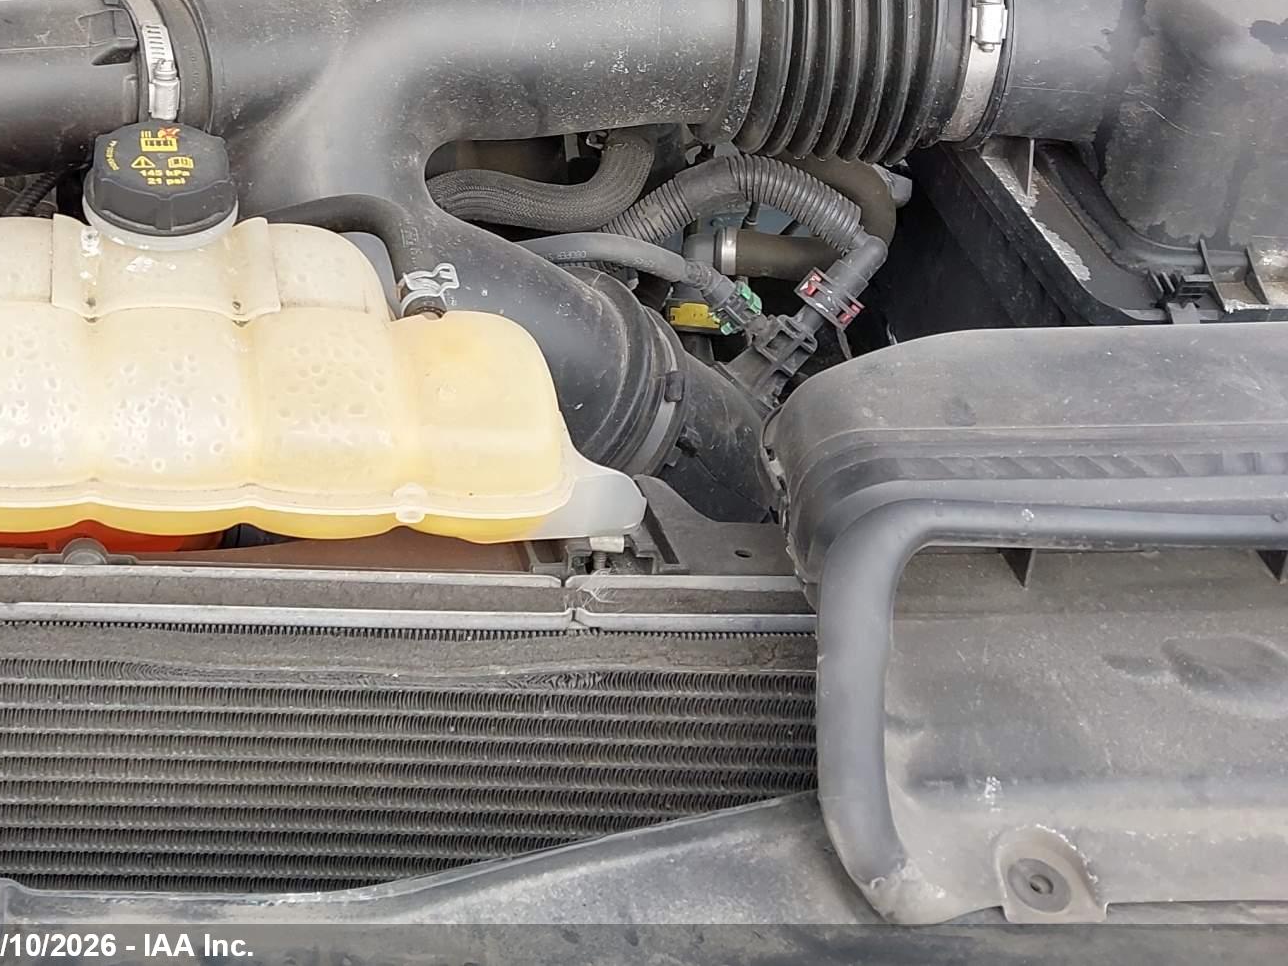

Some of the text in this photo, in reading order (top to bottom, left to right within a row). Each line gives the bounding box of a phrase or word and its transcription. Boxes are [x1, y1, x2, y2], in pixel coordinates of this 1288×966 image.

[139, 169, 191, 177] 145 kPa
[147, 177, 186, 186] 21 psi
